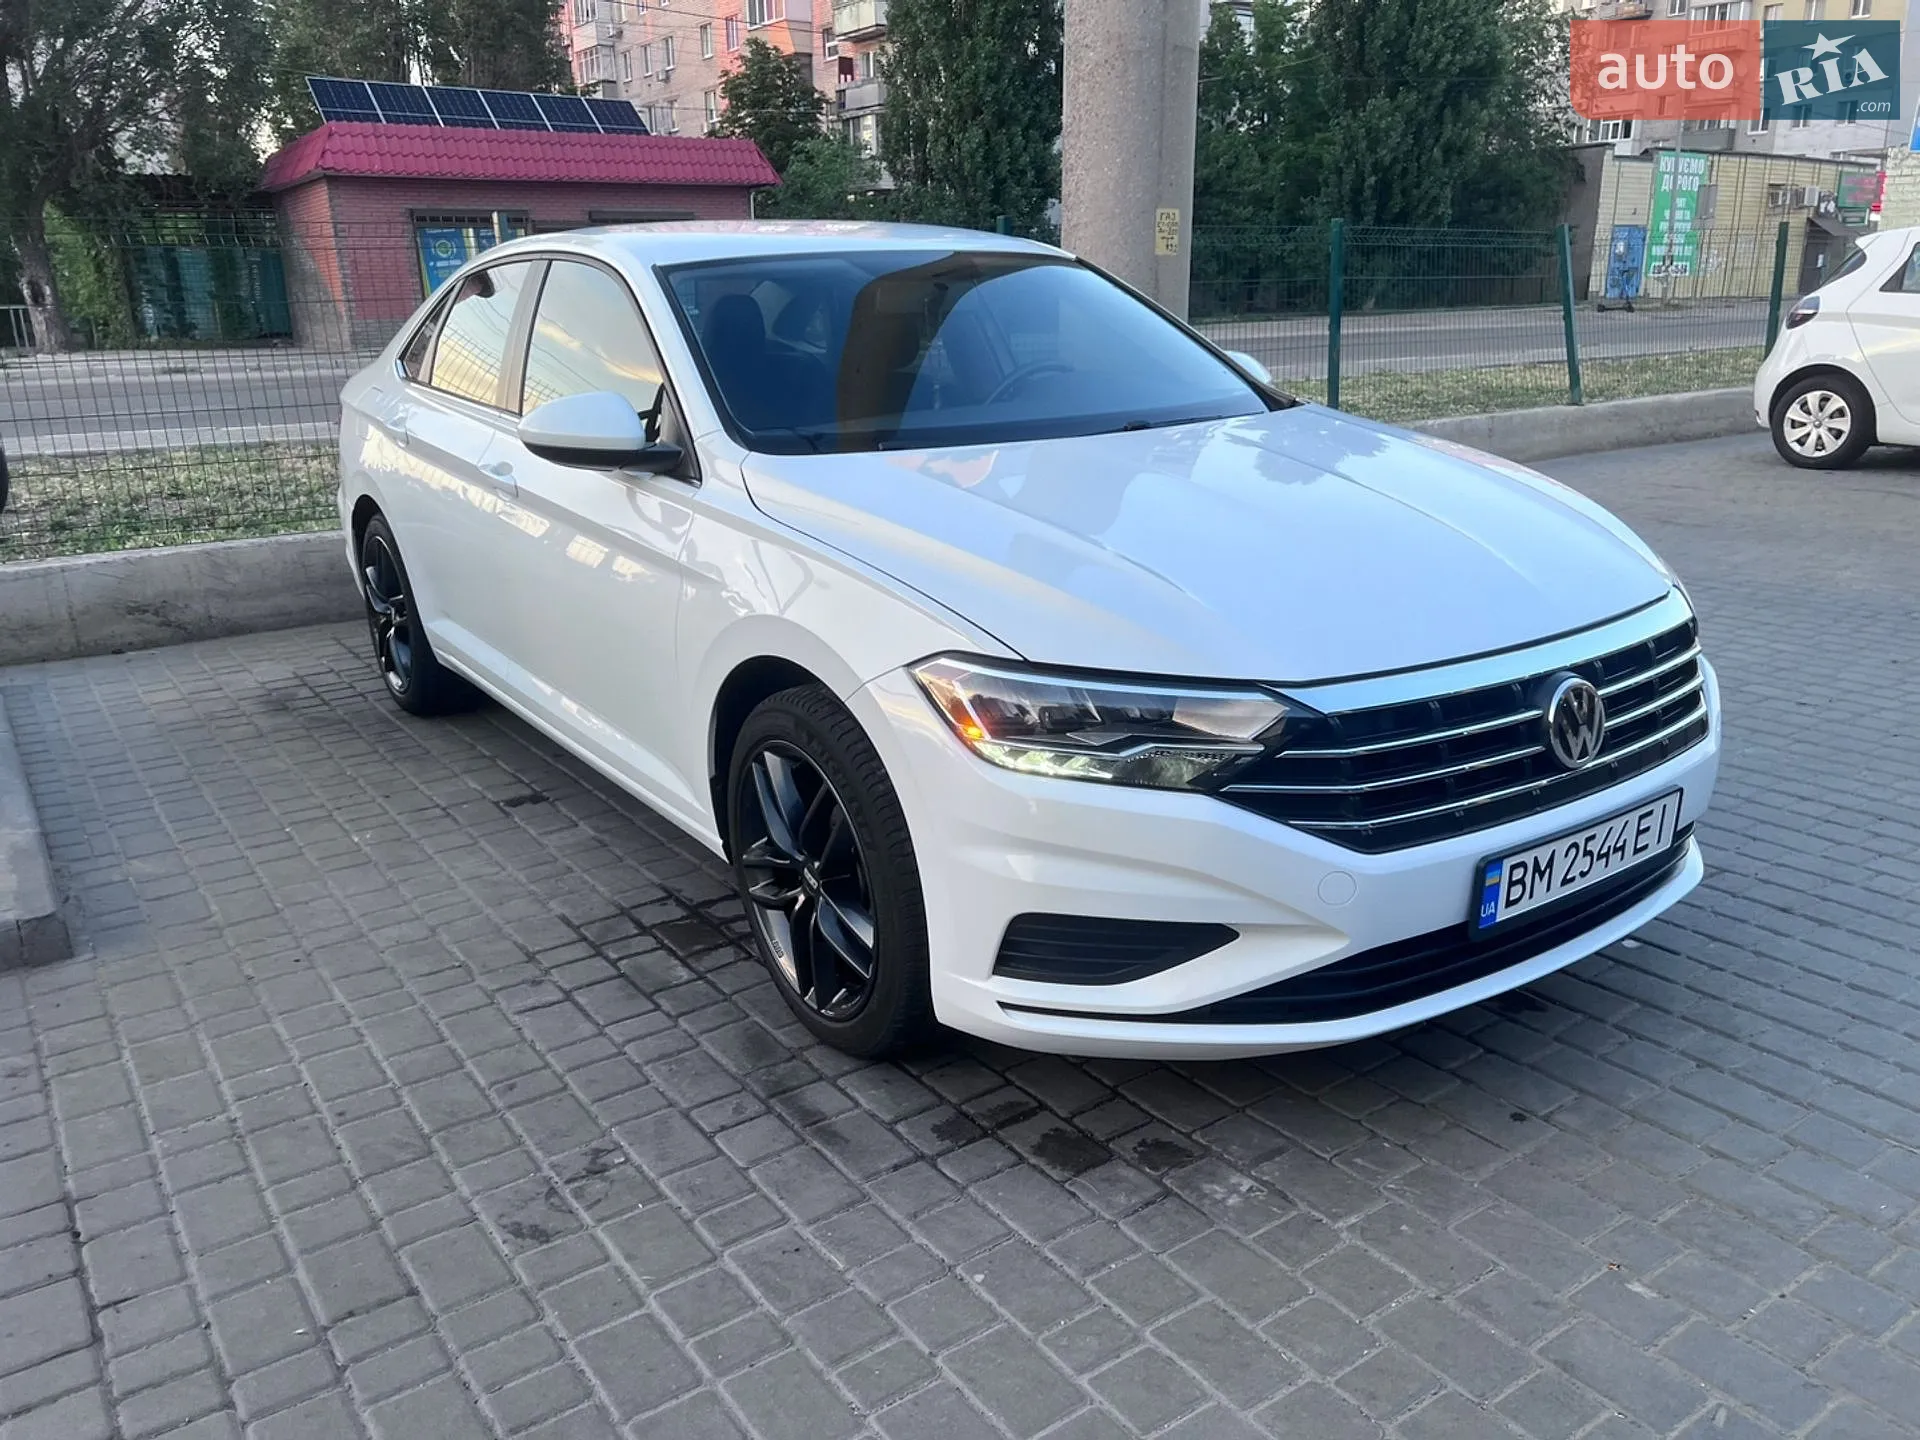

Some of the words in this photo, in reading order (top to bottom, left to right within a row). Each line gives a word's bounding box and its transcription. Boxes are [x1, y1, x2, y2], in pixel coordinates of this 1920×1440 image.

[1504, 849, 1556, 909] BM
[1560, 819, 1630, 888] 2544
[1632, 803, 1667, 857] EI
[1480, 900, 1496, 918] UA
